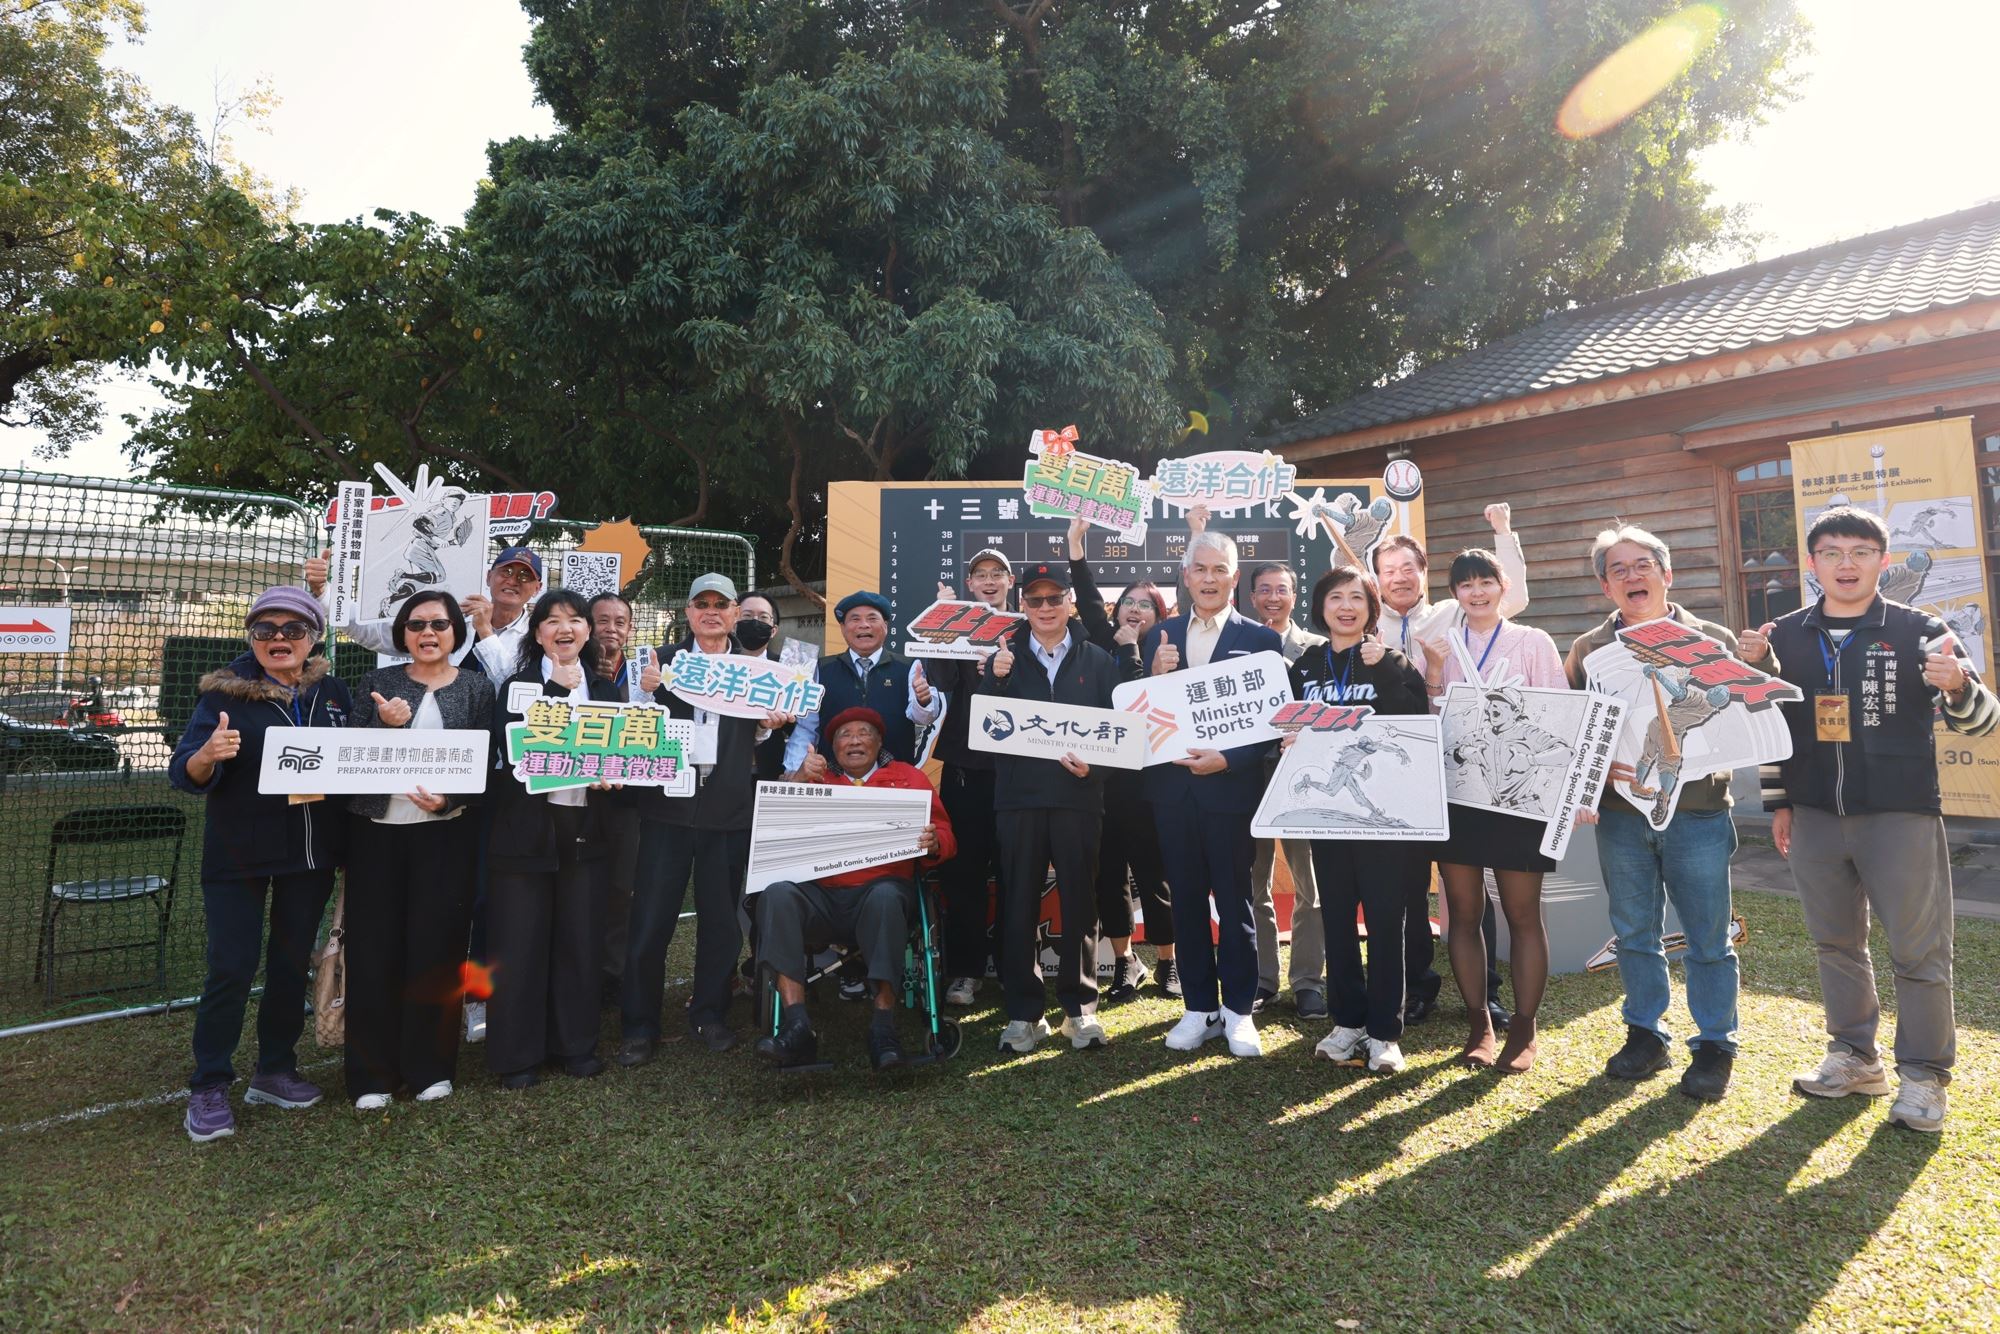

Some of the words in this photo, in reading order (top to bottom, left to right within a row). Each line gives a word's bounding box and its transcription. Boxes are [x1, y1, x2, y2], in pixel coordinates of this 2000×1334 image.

[1034, 451, 1135, 501] 雙百萬
[1158, 461, 1292, 496] 遠洋合作
[1802, 467, 1900, 489] 棒球漫畫主題特展
[1802, 486, 1834, 497] Baseball
[1835, 484, 1858, 494] Comic
[1860, 481, 1888, 492] Special
[1890, 477, 1932, 487] Exhibition
[343, 487, 352, 520] National
[923, 499, 1054, 520] 十三號
[1030, 482, 1136, 530] 運動漫畫徵選
[350, 488, 365, 560] 國家漫畫博物館
[489, 523, 528, 534] game?
[341, 522, 350, 549] Taiwan
[942, 531, 952, 539] 3B
[1048, 536, 1064, 544] 棒次
[1236, 535, 1260, 543] 投球數
[892, 558, 897, 566] 3
[942, 558, 952, 566] 2B
[1052, 546, 1060, 557] 4
[1166, 546, 1186, 557] 145
[1242, 546, 1255, 557] 13
[338, 551, 347, 586] Museum
[891, 572, 897, 580] 4
[940, 572, 954, 580] DH
[1300, 572, 1306, 580] 4
[338, 587, 345, 595] of
[892, 586, 897, 594] 5
[1301, 586, 1307, 594] 5
[335, 596, 344, 622] Comics
[891, 600, 896, 608] 6
[1302, 600, 1308, 608] 6
[890, 614, 896, 622] 7
[630, 662, 639, 686] Gallery
[1618, 618, 1800, 712] 壘上有人
[1866, 660, 1876, 678] 里長
[671, 652, 822, 714] 遠洋合作
[1186, 668, 1266, 705] 運動部
[1302, 680, 1378, 701] Taiwan
[1884, 660, 1898, 714] 南區新榮里
[1192, 698, 1264, 725] Ministry
[1269, 690, 1287, 708] of
[1861, 680, 1880, 726] 陳宏誌
[522, 700, 664, 750] 雙百萬
[1195, 716, 1254, 740] Sports
[1270, 703, 1372, 732] 壘上有人
[1584, 701, 1602, 742] Baseball
[1020, 714, 1128, 744] 文化部
[338, 746, 474, 763] 國家漫畫博物館籌備處
[1027, 736, 1066, 748] MINISTRY
[1066, 742, 1078, 750] OF
[1080, 742, 1118, 754] CULTURE
[519, 750, 678, 782] 運動漫畫徵選
[1575, 742, 1590, 771] Comic
[1580, 704, 1621, 808] 棒球漫畫主題特展
[1978, 758, 2000, 766] (Sun)
[337, 766, 401, 775] PREPARATORY
[403, 767, 433, 775] OFFICE
[434, 767, 446, 775] OF
[448, 767, 472, 775] NTMC
[760, 786, 833, 797] 棒球漫畫主題特展
[1564, 770, 1582, 805] Special
[1550, 806, 1572, 851] Exhibition
[814, 860, 843, 872] Baseball
[844, 858, 864, 868] Comic
[864, 852, 889, 864] Special
[890, 848, 923, 859] Exhibition
